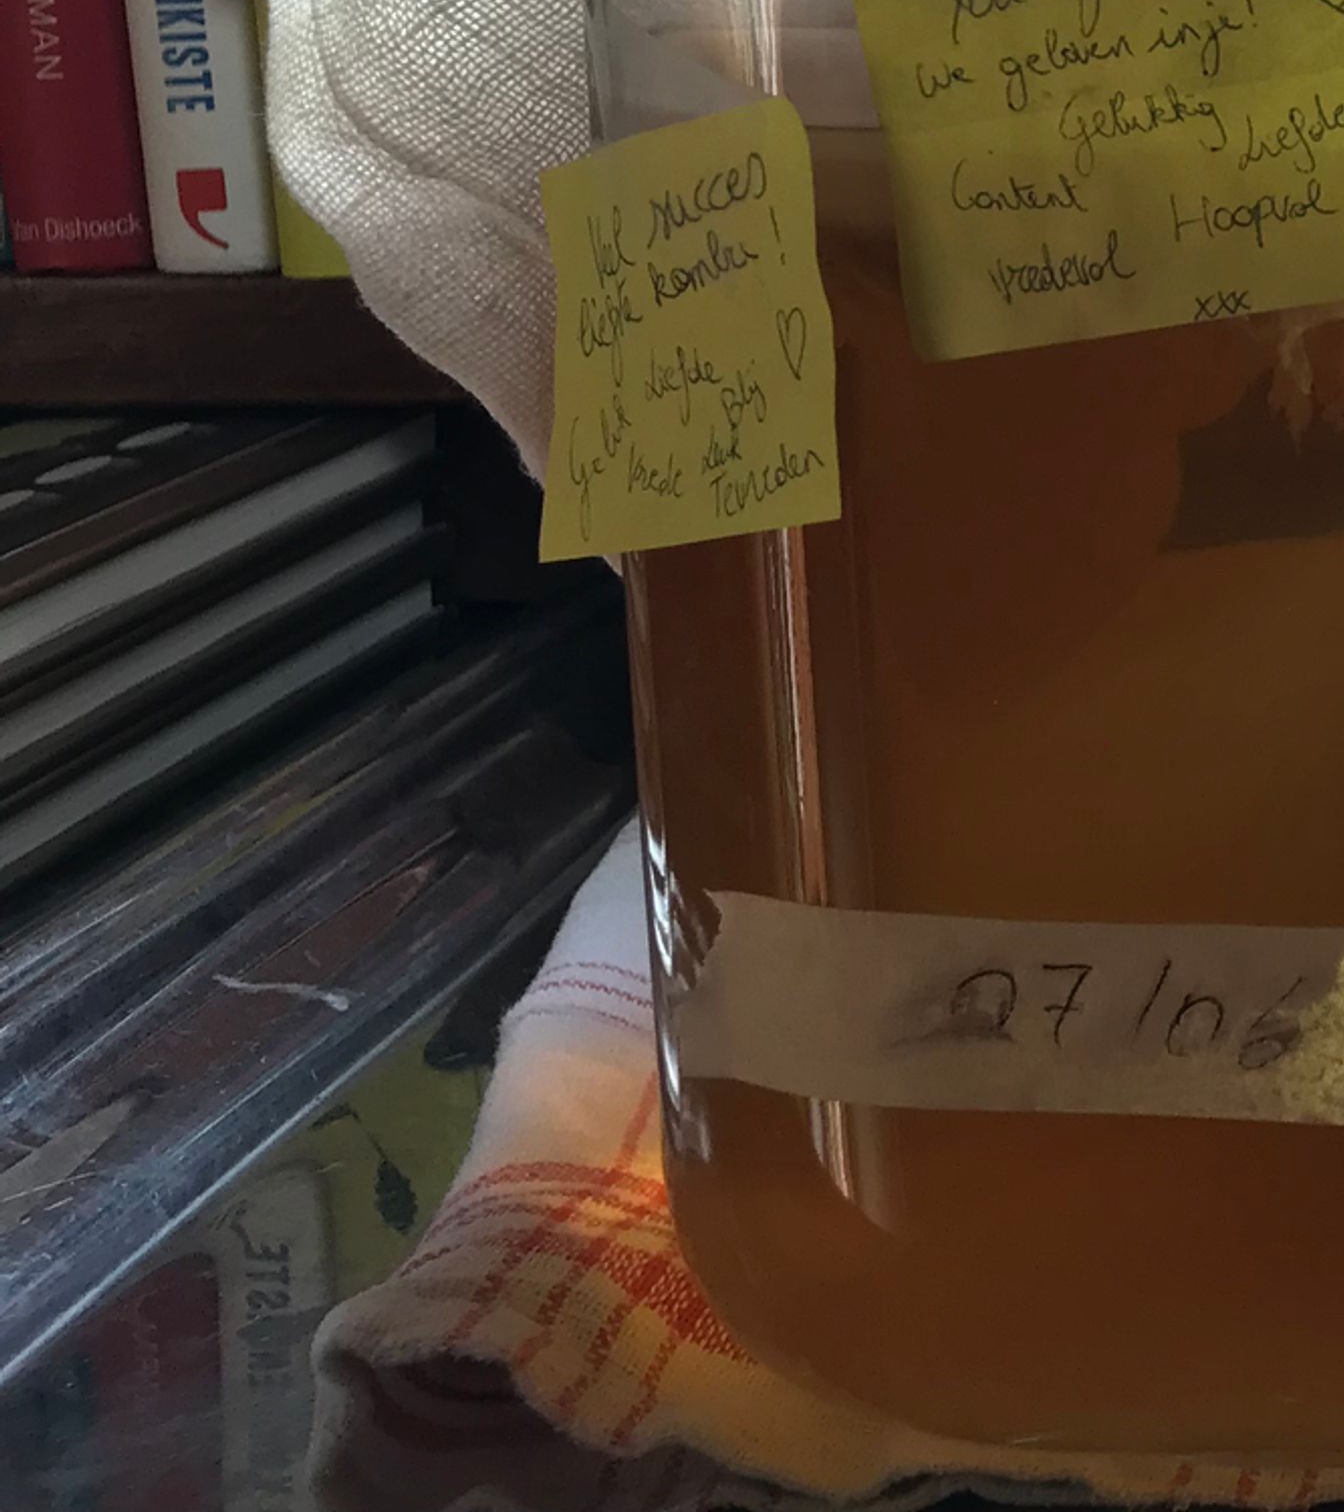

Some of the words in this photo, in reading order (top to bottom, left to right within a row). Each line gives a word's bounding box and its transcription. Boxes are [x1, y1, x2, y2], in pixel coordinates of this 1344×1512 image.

[916, 61, 972, 101] we
[999, 30, 1136, 112] geloven
[43, 210, 144, 244] Dishoeck
[647, 152, 767, 250] succes
